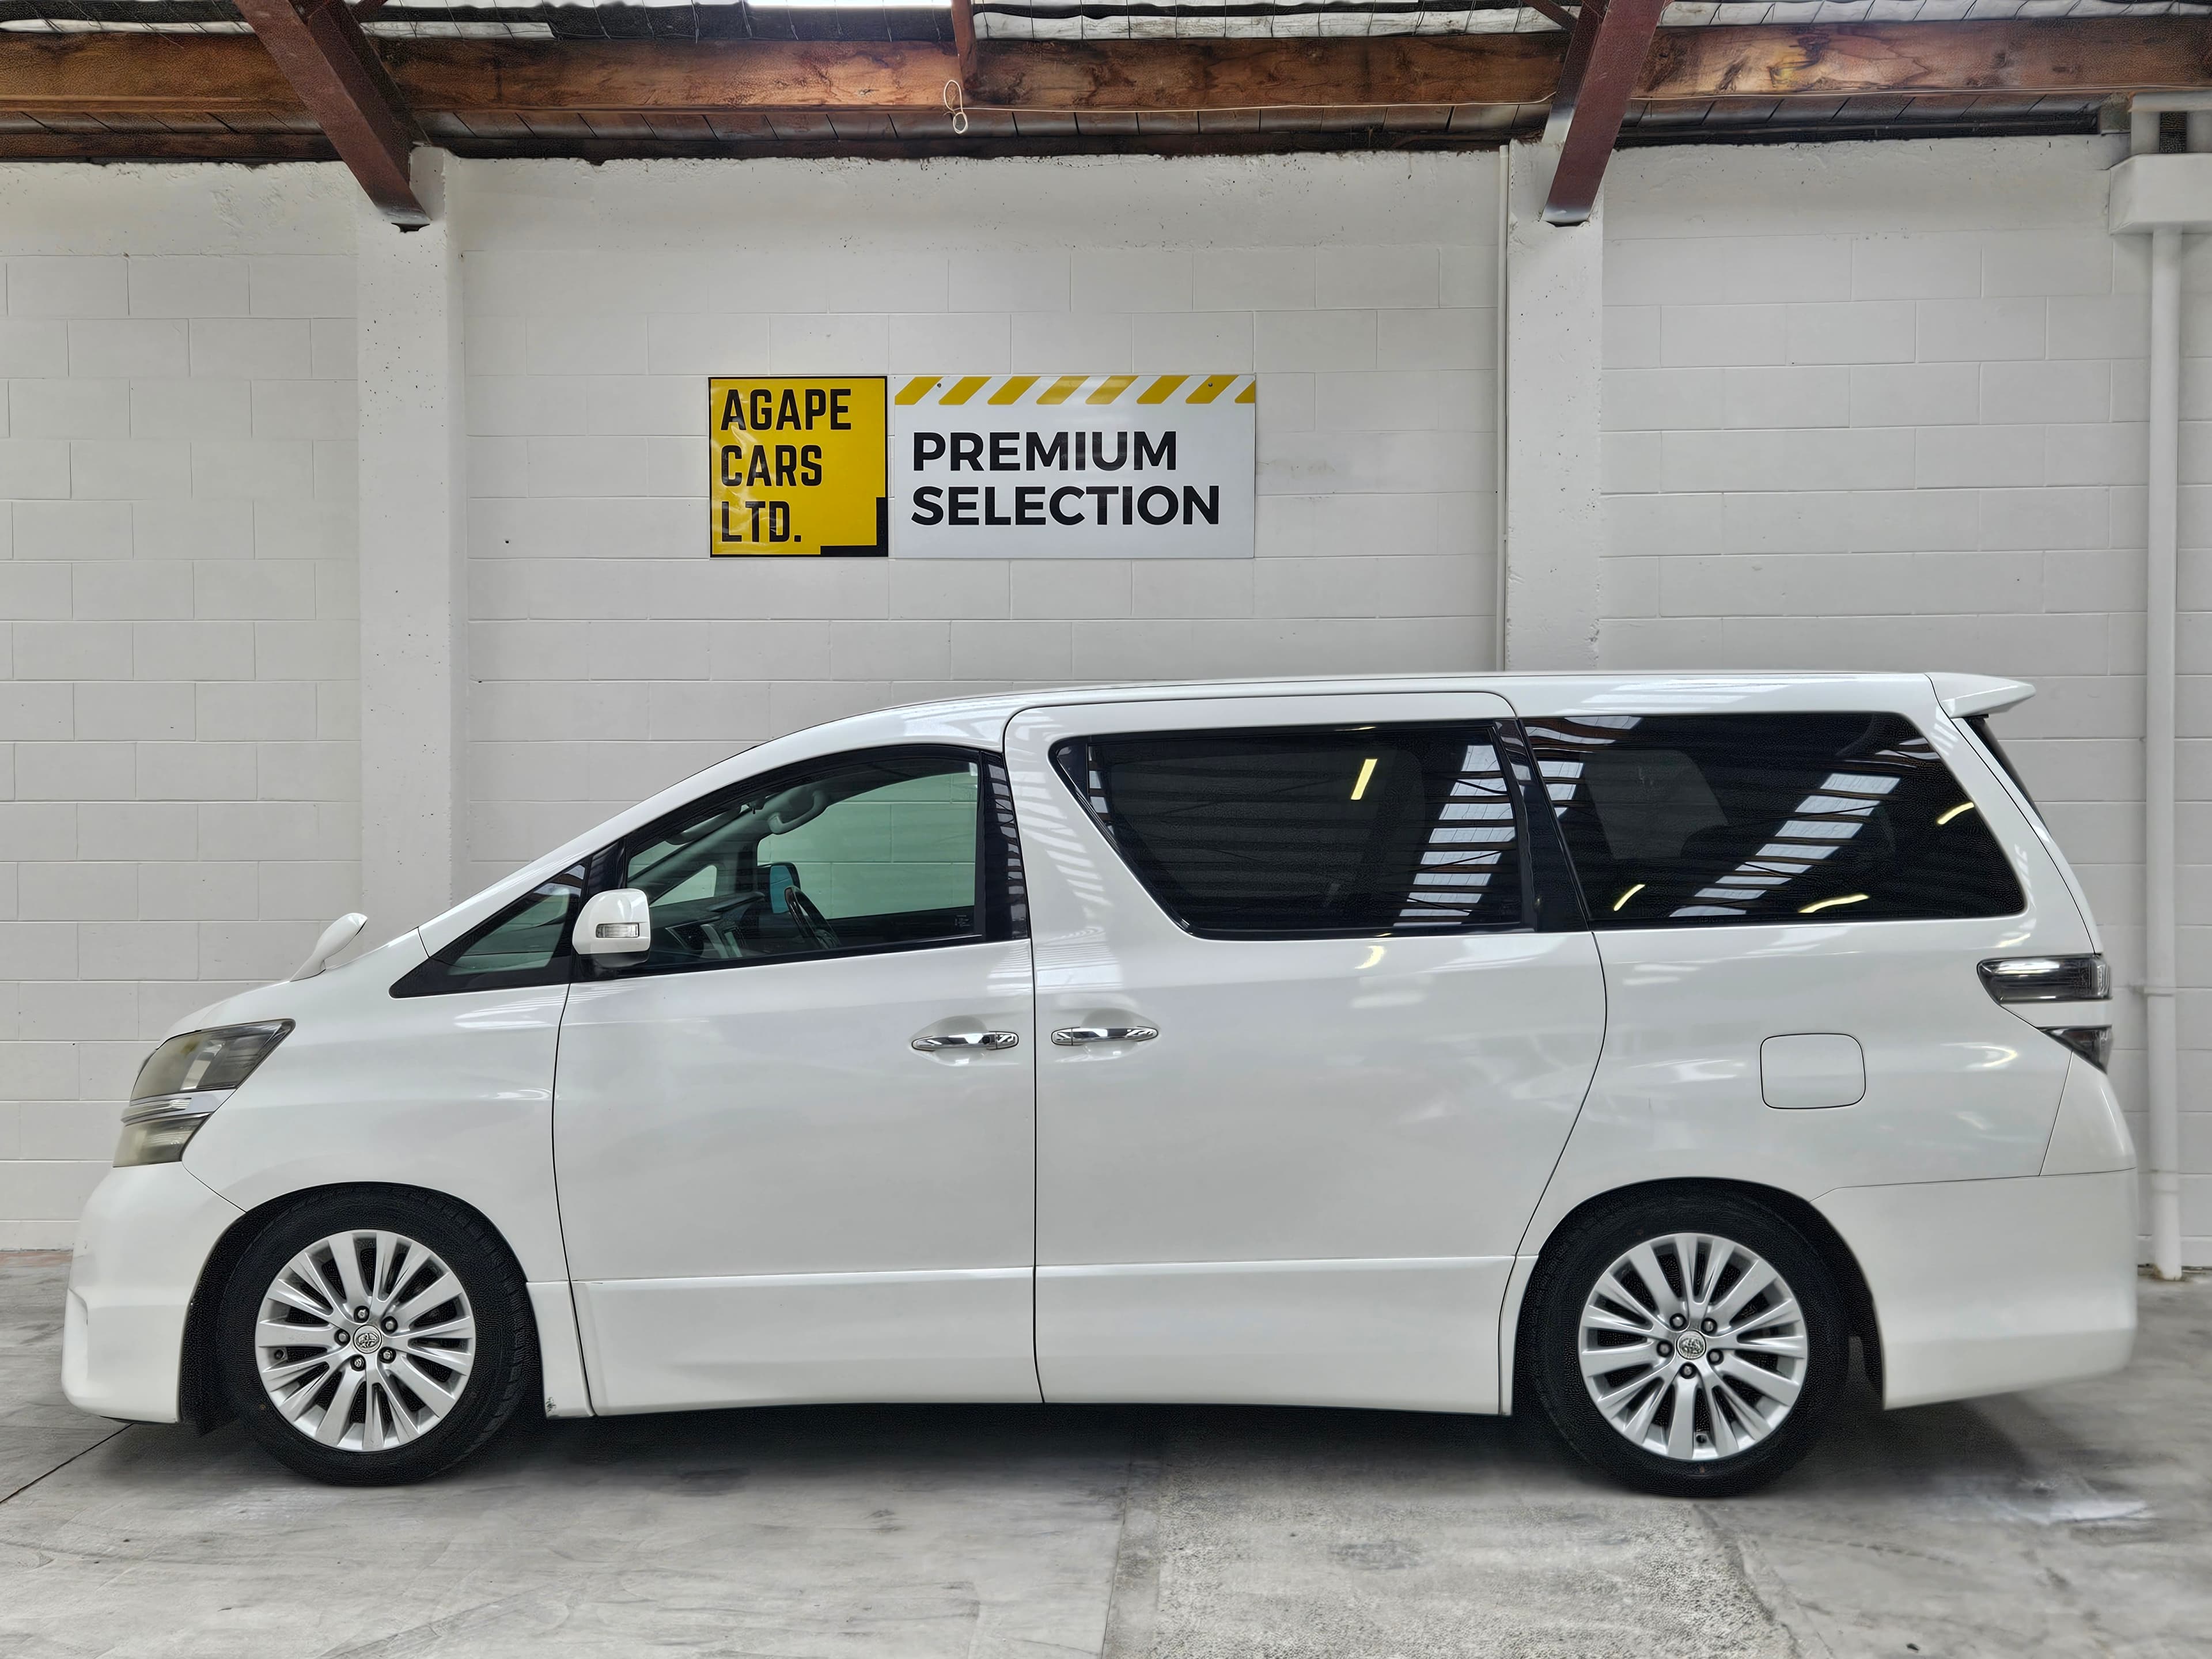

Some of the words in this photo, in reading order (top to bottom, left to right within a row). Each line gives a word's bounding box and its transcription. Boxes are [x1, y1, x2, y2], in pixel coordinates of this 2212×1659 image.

[721, 389, 851, 431] AGAPE
[721, 445, 822, 487] CARS
[912, 431, 1176, 471] PREMIUM
[721, 501, 802, 543] LTD.
[911, 486, 1219, 526] SELECTION
